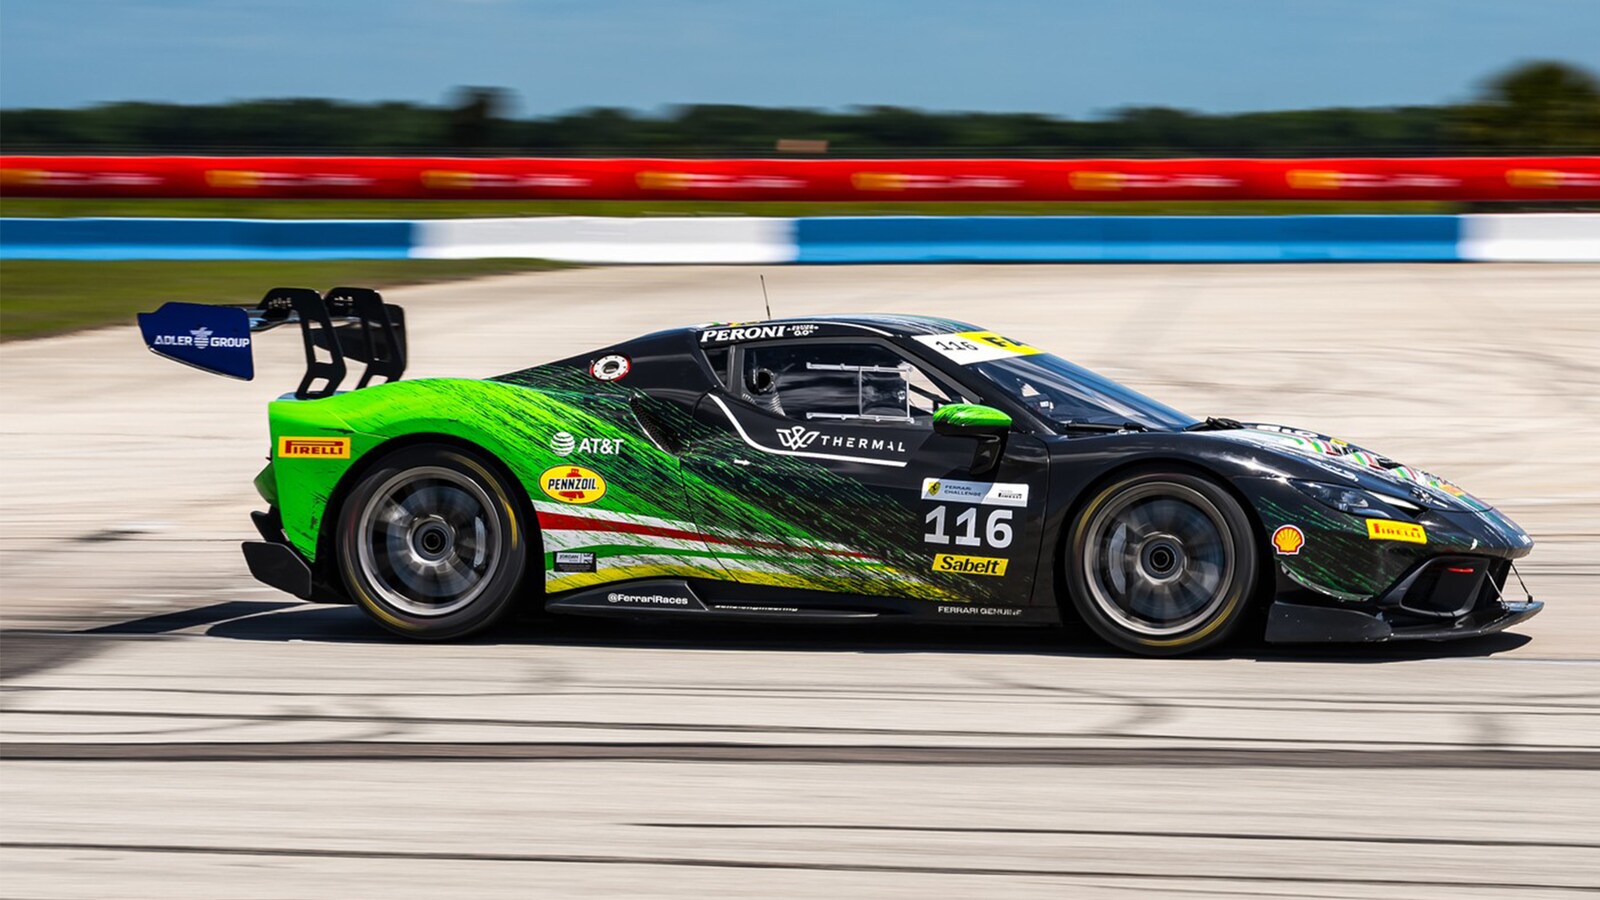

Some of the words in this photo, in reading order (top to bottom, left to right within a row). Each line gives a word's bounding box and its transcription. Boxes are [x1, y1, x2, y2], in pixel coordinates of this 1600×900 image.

[154, 335, 193, 346] ADLER
[210, 336, 250, 348] GROUP
[700, 325, 786, 343] PERONI
[935, 341, 979, 351] 116
[285, 440, 344, 455] PIRELLI
[578, 437, 625, 455] AT&T
[821, 435, 906, 453] THERMAL
[547, 478, 596, 490] PENNZOIL
[924, 505, 1013, 549] 116
[1373, 523, 1421, 539] PIRELLI
[940, 555, 1001, 574] Sabelt
[607, 592, 688, 605] @FerrariRaces
[937, 605, 979, 615] FERRARI
